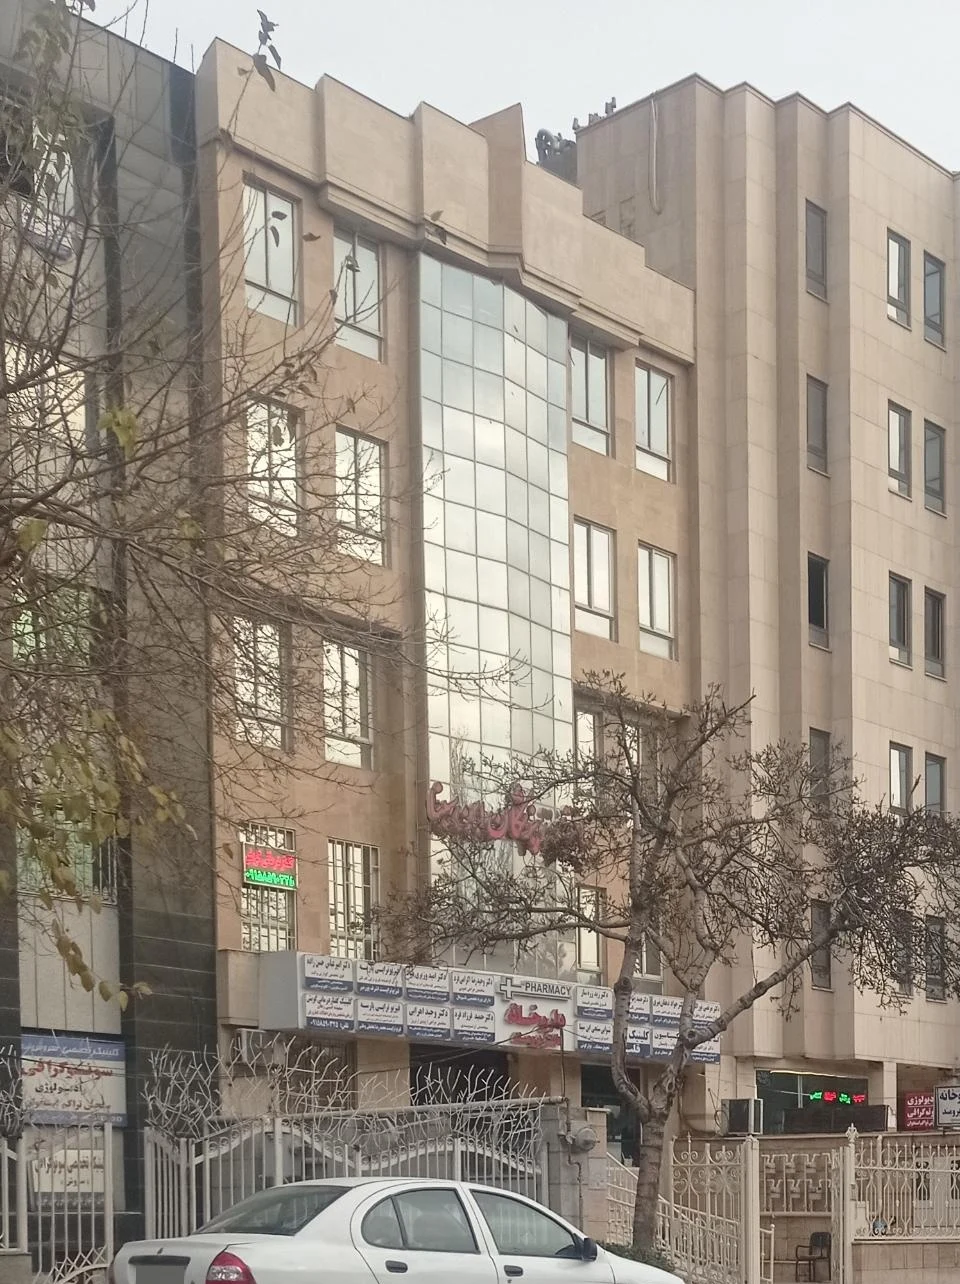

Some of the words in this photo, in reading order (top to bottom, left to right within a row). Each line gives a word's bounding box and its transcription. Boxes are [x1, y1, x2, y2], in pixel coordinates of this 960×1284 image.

[525, 982, 571, 995] PHARMACY
[629, 1029, 649, 1043] کلینیک
[907, 1094, 934, 1106] دیولوژی
